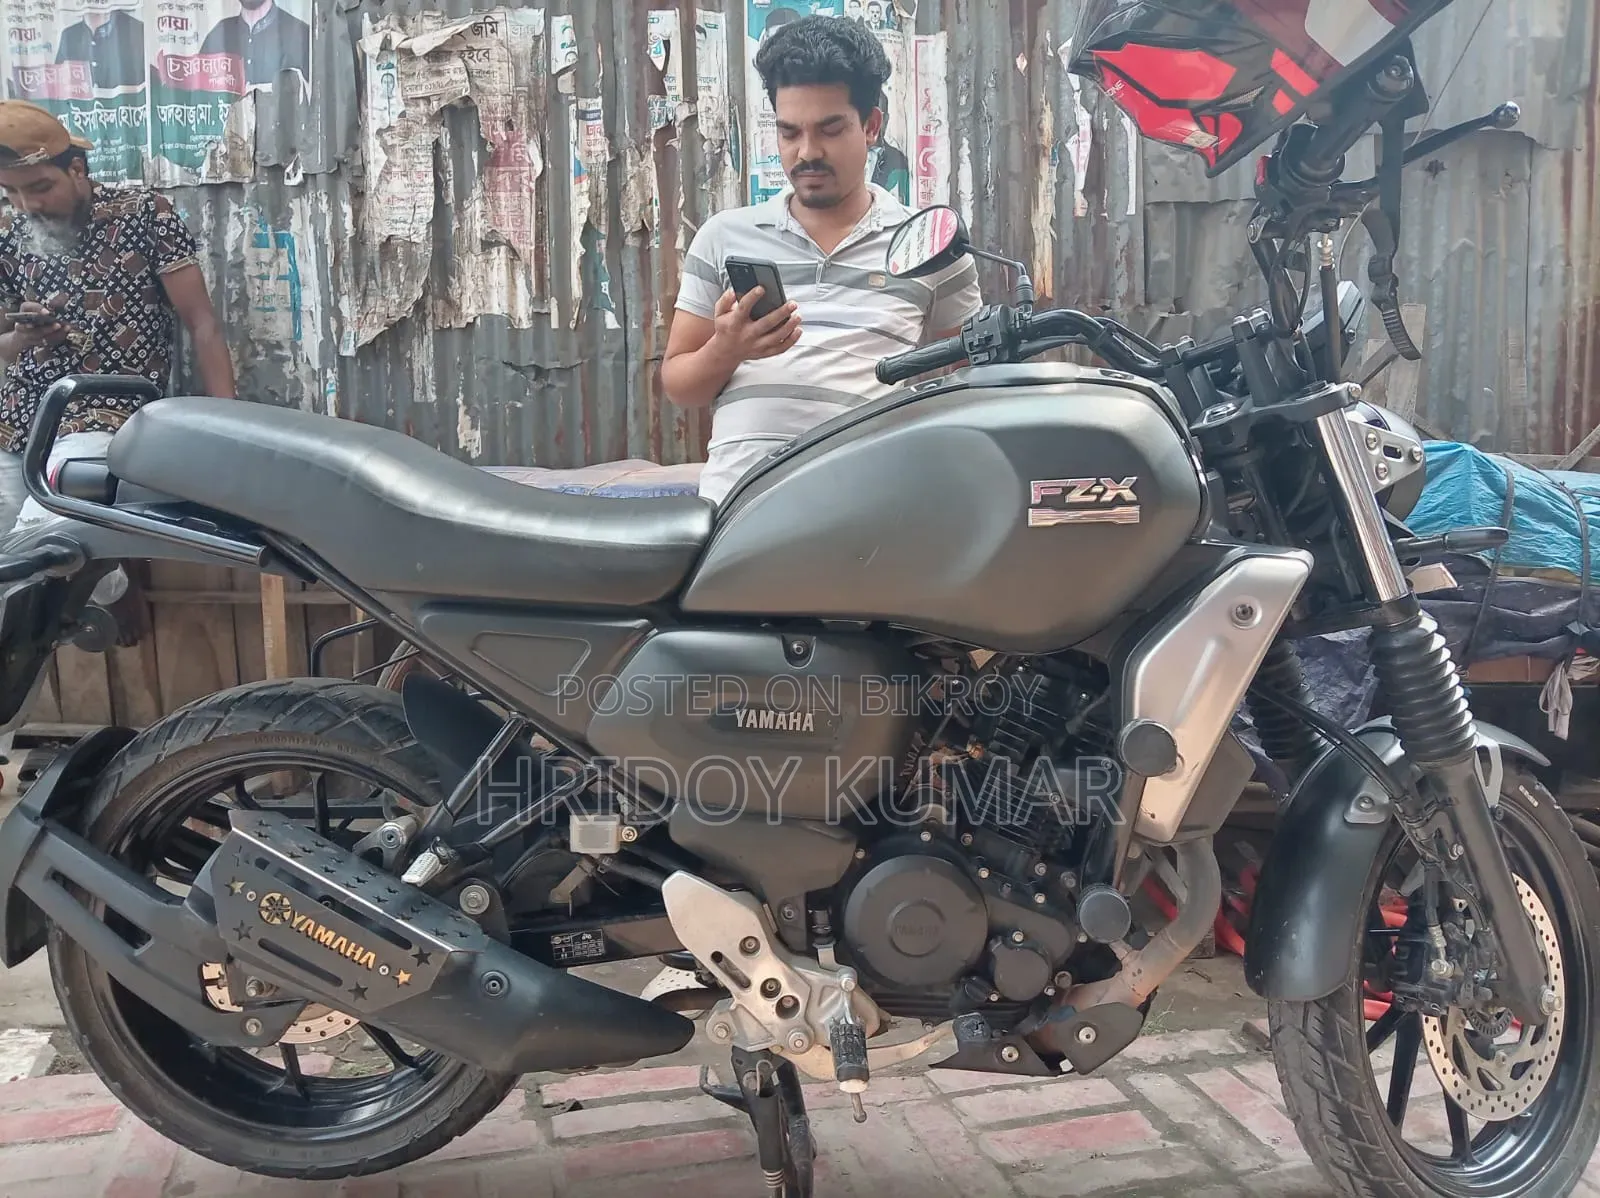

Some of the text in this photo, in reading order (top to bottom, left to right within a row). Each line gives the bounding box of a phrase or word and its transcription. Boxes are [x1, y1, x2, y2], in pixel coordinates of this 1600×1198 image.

[471, 15, 499, 38] জমি
[1031, 476, 1138, 504] FZ-X
[736, 708, 815, 732] YAMAHA
[289, 909, 377, 970] YAMAHA
